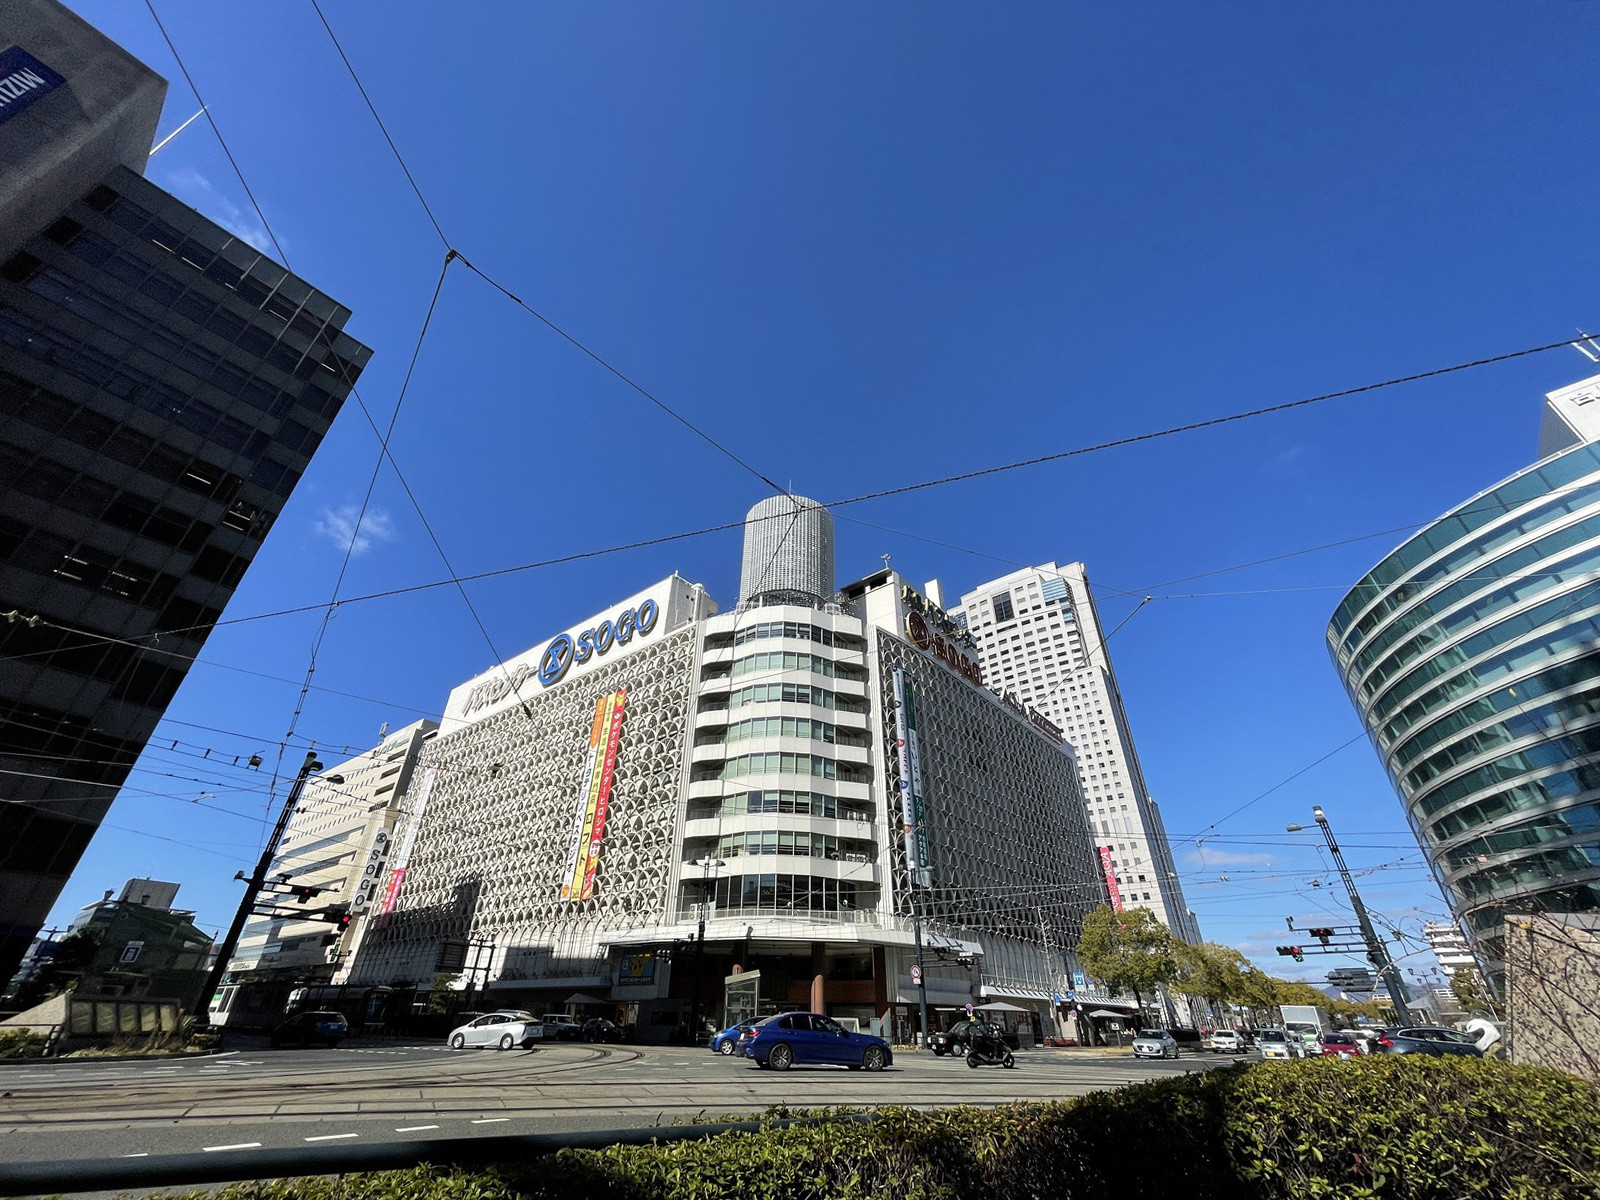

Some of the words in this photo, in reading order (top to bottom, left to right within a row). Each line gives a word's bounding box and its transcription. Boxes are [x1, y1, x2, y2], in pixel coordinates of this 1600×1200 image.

[0, 67, 45, 107] MIZU
[574, 598, 659, 664] SOGO
[594, 721, 620, 836] ポケモンセンターヒロシマ
[579, 812, 594, 867] ロフト
[355, 849, 381, 906] SOGO
